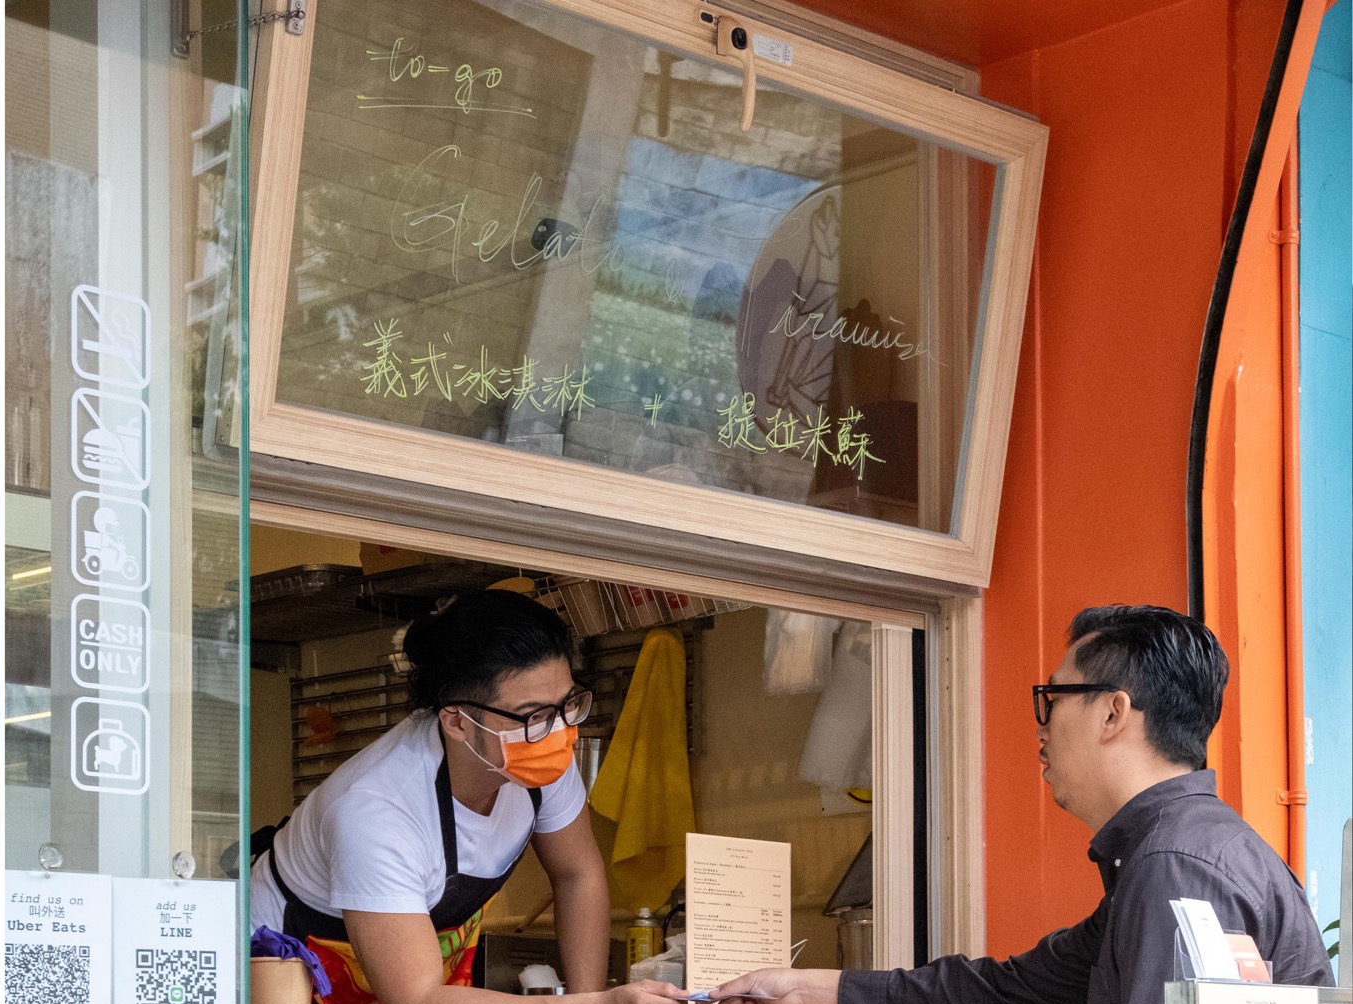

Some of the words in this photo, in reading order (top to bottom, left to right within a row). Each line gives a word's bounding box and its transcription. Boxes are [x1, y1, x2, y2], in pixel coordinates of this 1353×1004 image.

[366, 37, 503, 113] to-go
[391, 145, 626, 283] Gelato
[360, 318, 597, 421] 義式冰淇淋
[717, 392, 887, 480] 提拉米蘇
[79, 618, 143, 647] CASH
[79, 648, 142, 675] ONLY
[11, 893, 40, 904] find
[48, 896, 62, 905] us
[69, 897, 84, 906] on
[156, 901, 176, 911] add
[183, 903, 197, 912] us
[29, 905, 66, 919] 叫外送
[159, 912, 193, 925] 加一下
[7, 920, 43, 932] Uber
[52, 921, 87, 934] Eats
[160, 927, 193, 938] LINE
